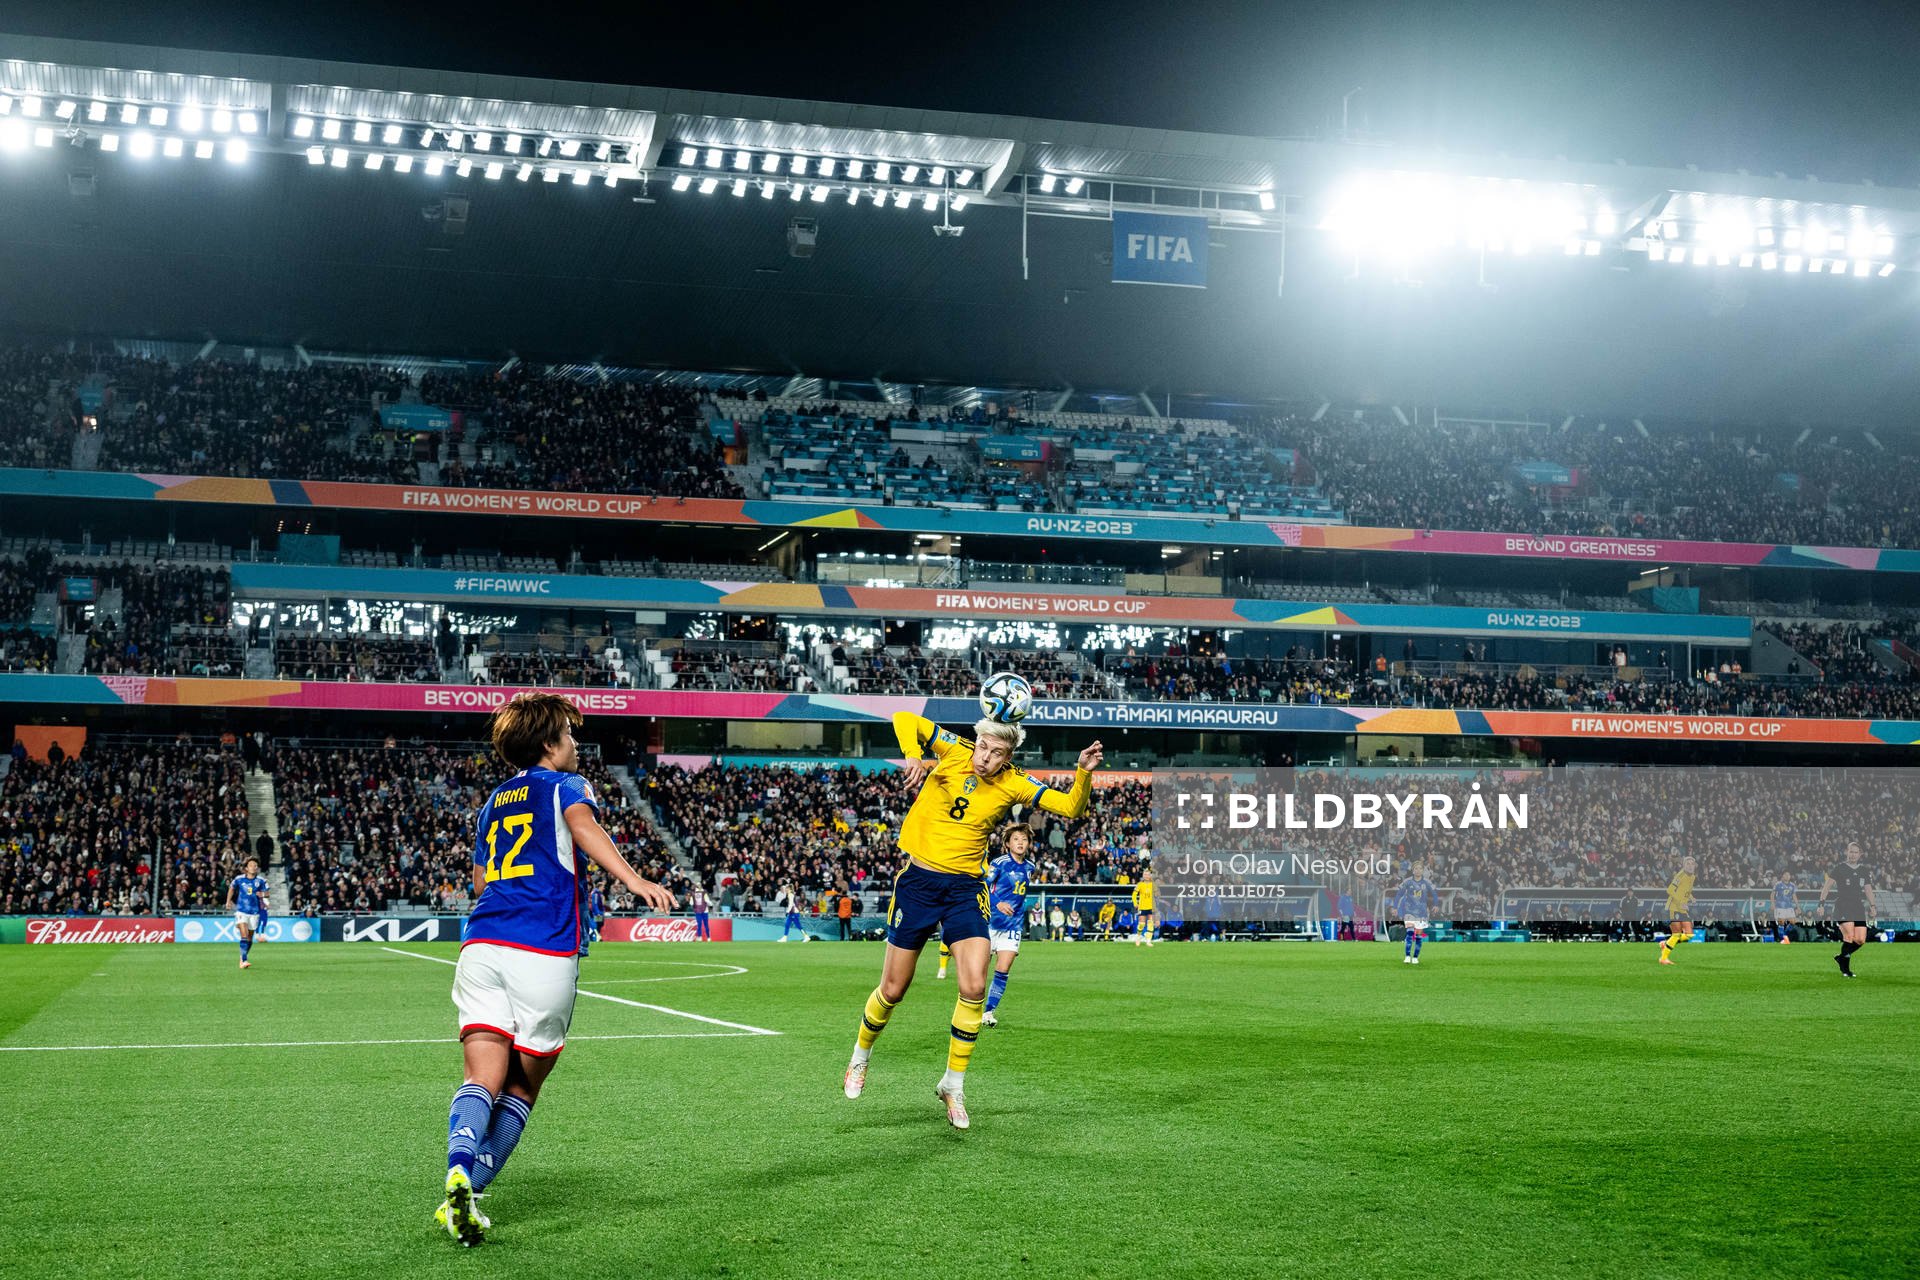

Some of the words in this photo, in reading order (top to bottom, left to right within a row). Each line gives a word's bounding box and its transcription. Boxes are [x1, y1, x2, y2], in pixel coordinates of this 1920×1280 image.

[1127, 233, 1193, 263] FIFA
[402, 491, 441, 506] FIFA
[444, 493, 531, 510] WOMEN'S
[536, 497, 600, 513] WORLD
[606, 500, 642, 514] CUP
[1505, 538, 1566, 553] BEYOND
[1570, 541, 1656, 556] GREATNESS
[453, 577, 551, 593] #FIFAWWC
[936, 594, 970, 608] FIFA
[972, 596, 1049, 611] WOMEN'S
[1053, 599, 1109, 613] WORLD
[1113, 601, 1146, 614] CUP
[424, 690, 506, 706] BEYOND
[1105, 704, 1173, 723] TĀMAKI
[1177, 709, 1278, 725] MAKAURAU
[1571, 718, 1605, 732] FIFA
[1608, 719, 1684, 735] WOMEN'S
[1688, 721, 1745, 736] WORLD
[1749, 723, 1781, 737] CUP
[1092, 773, 1135, 786] OMEN'S
[494, 786, 530, 809] HANA
[949, 796, 970, 822] 8
[484, 813, 535, 883] 12
[1012, 880, 1027, 896] 16
[27, 919, 175, 944] Budweiser
